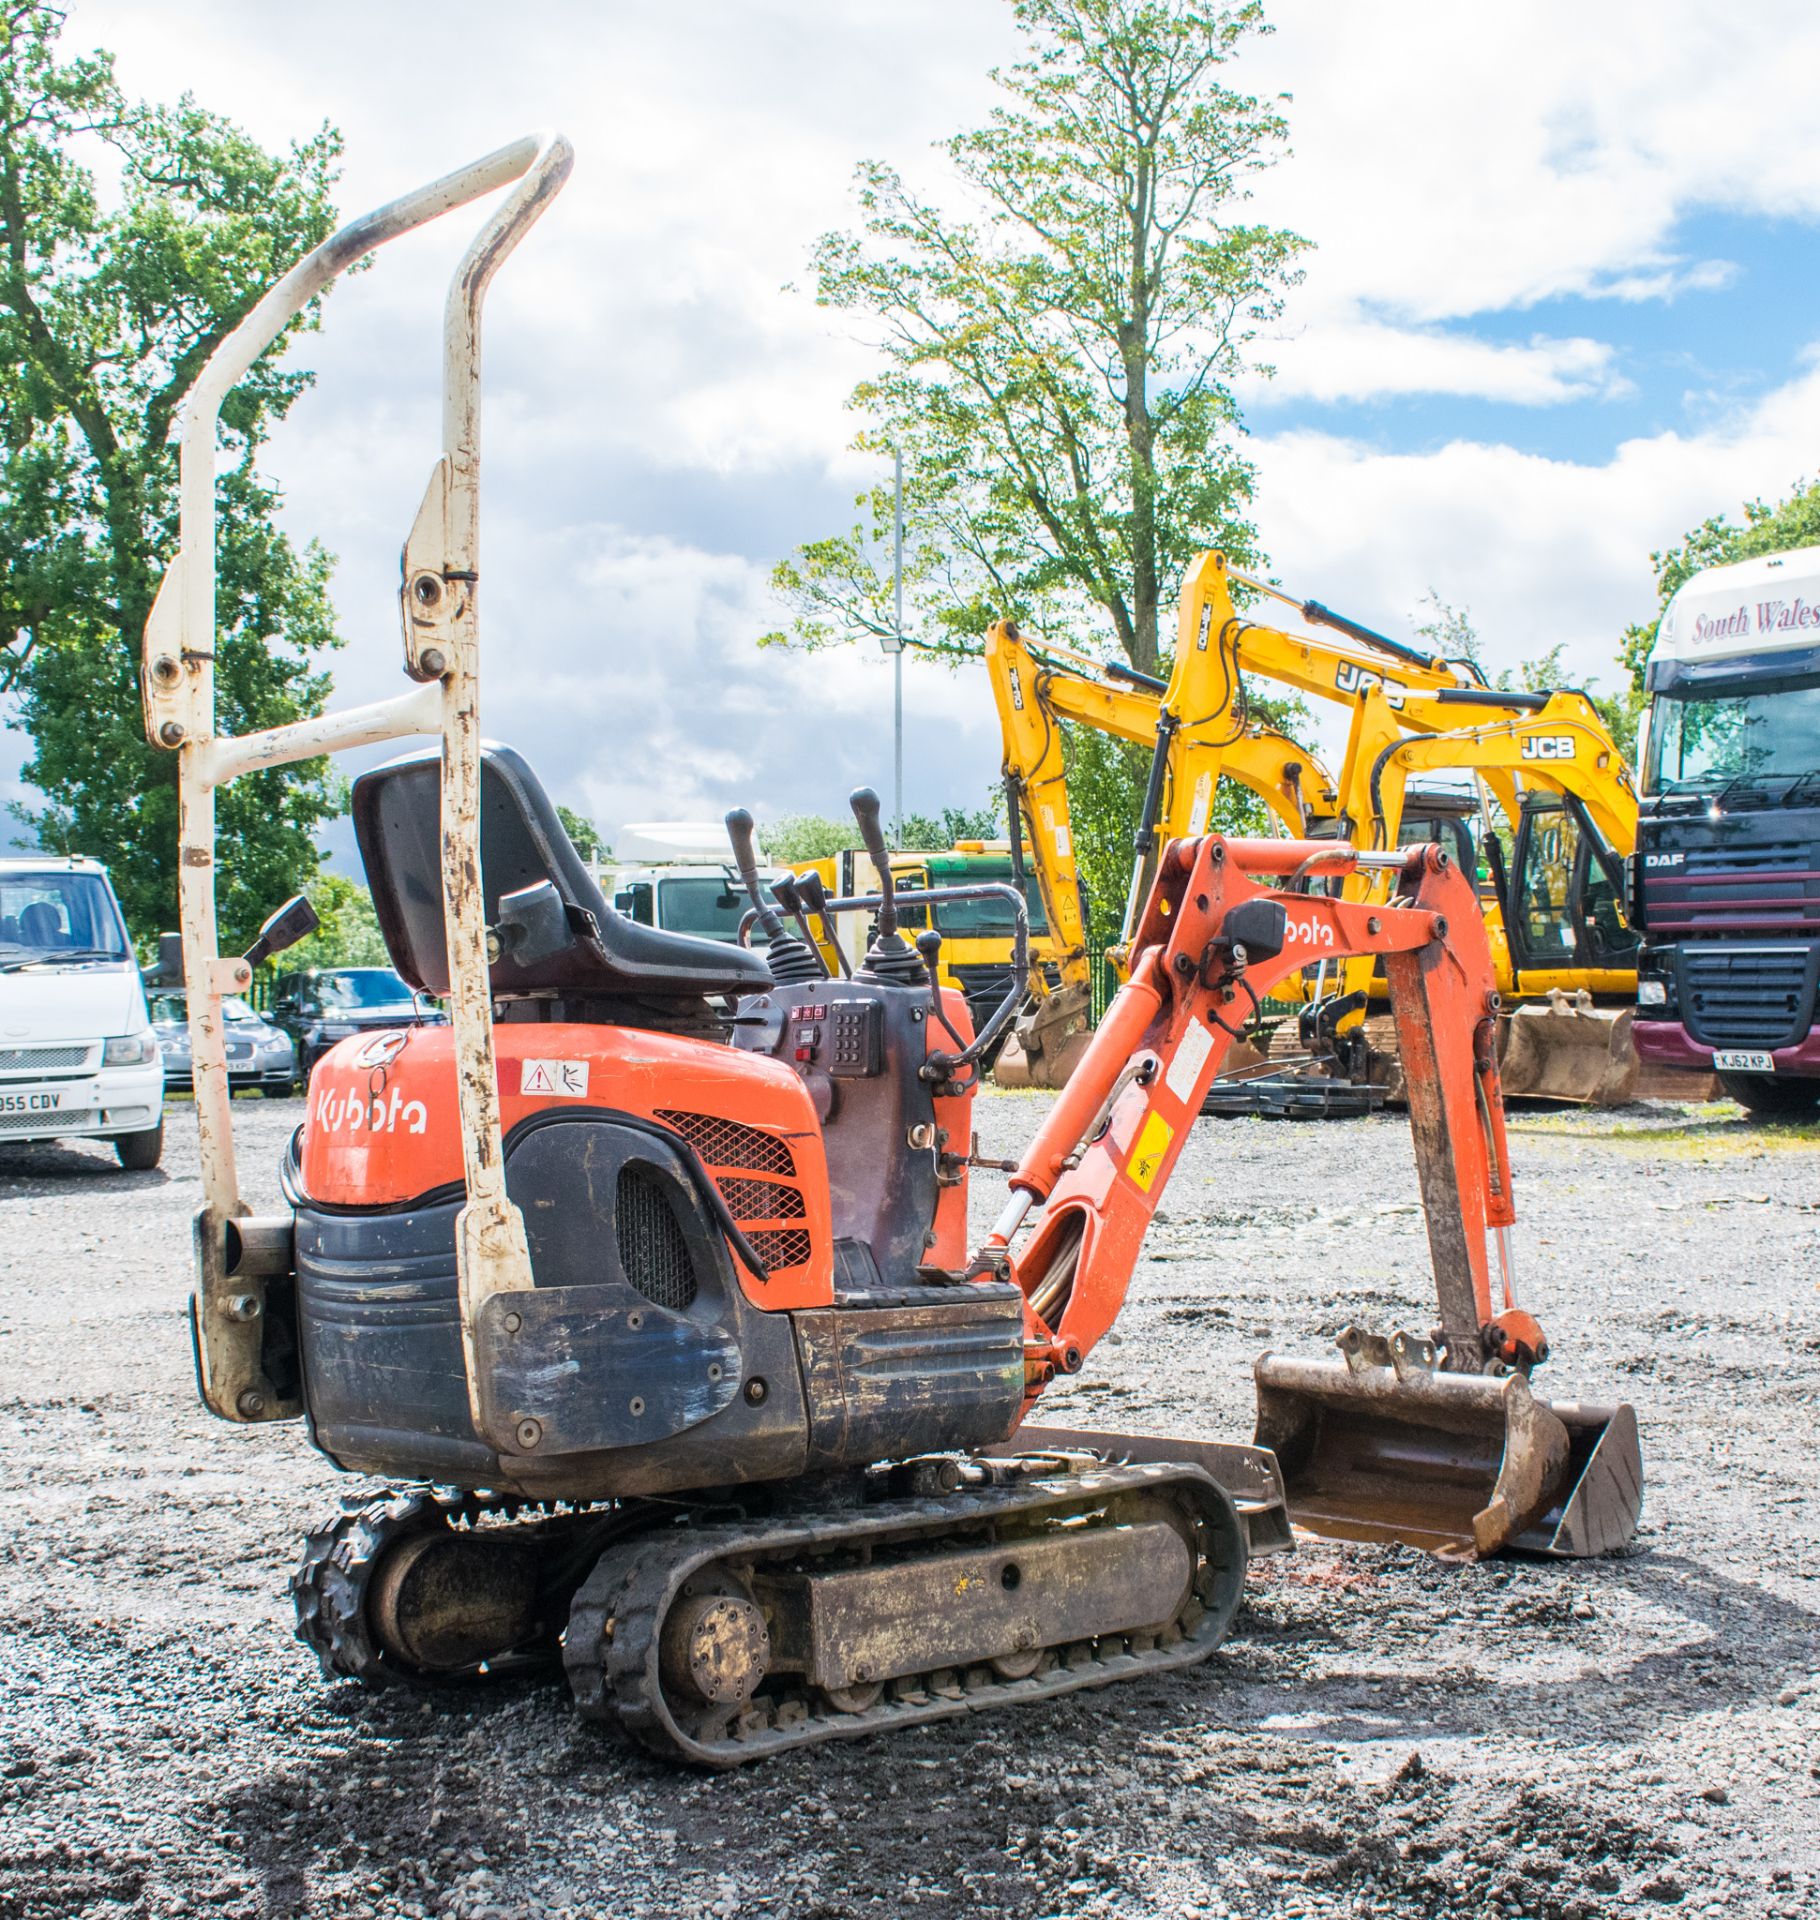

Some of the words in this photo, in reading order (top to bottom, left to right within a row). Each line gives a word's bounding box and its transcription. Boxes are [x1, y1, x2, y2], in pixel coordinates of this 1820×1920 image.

[1692, 605, 1750, 644] South
[1756, 597, 1820, 634] Wales
[1522, 736, 1575, 759] JCB
[1645, 853, 1684, 867] DAF
[1720, 1055, 1749, 1068] KJ62
[1750, 1055, 1772, 1069] KPJ
[29, 1093, 60, 1110] CDV
[316, 1087, 428, 1134] Kubota
